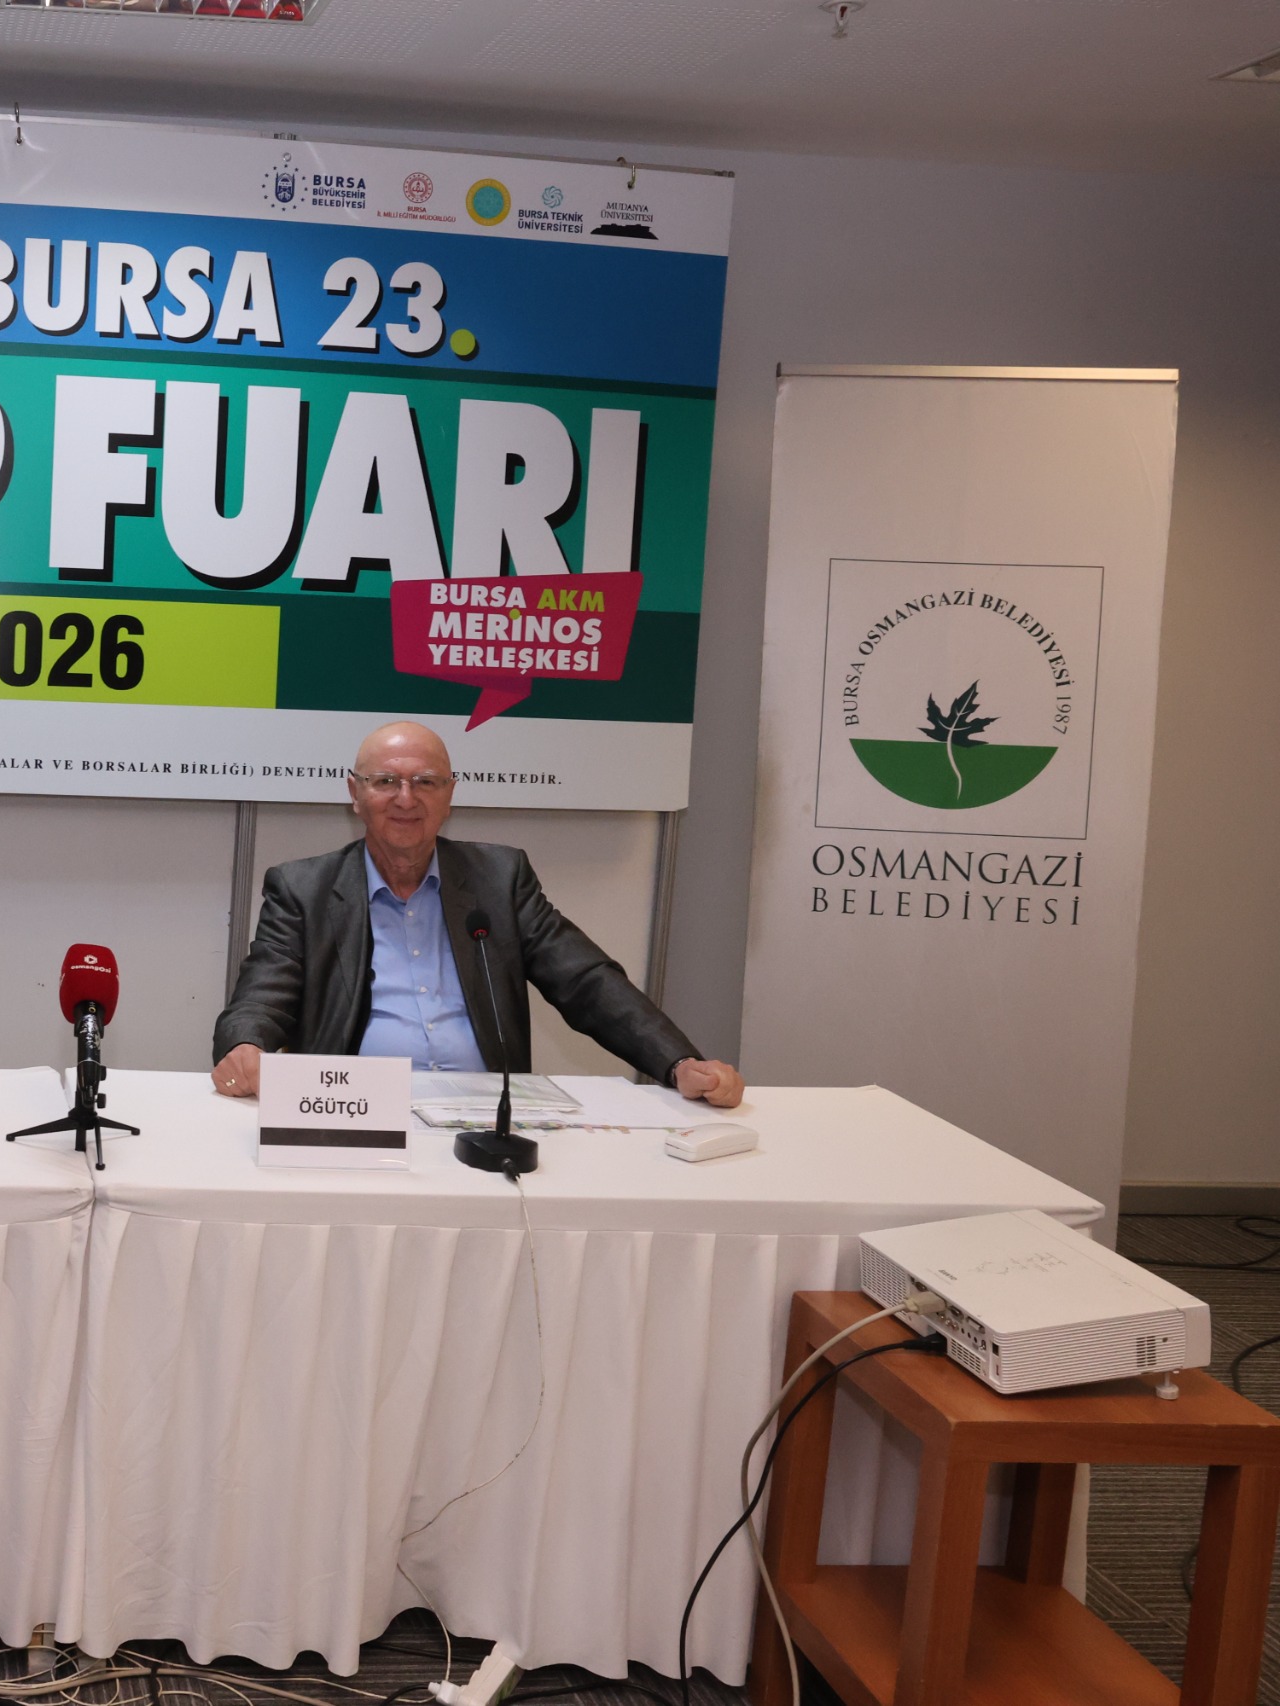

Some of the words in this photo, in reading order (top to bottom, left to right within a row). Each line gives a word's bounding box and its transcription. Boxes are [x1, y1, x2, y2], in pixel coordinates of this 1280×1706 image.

[313, 174, 366, 189] BURSA
[312, 187, 366, 199] BÜYÜKŞEHİR
[312, 197, 365, 209] BELEDİYESİ
[518, 209, 548, 219] BURSA
[551, 211, 583, 222] TEKNİK
[518, 219, 583, 233] ÜNİVERSİTESİ
[317, 256, 477, 358] 23.
[48, 374, 644, 583] FUARI
[430, 584, 526, 609] BURSA
[536, 587, 605, 612] AKM
[428, 608, 603, 645] MERİNOS
[428, 643, 598, 676] YERLEŞKESİ
[843, 660, 865, 727] BURSA
[858, 588, 975, 656] OSMANGAZİ
[979, 593, 1075, 687] BELEDİYESİ
[1052, 695, 1072, 735] 1987
[52, 759, 74, 770] VE
[81, 760, 172, 774] BORSALAR
[180, 761, 255, 777] BİRLİĞİ)
[262, 764, 356, 778] DENETİMİN
[452, 771, 562, 784] ENMEKTEDİR.
[812, 843, 1084, 888] OSMANGAZİ
[812, 886, 1080, 926] BELEDİYESİ
[320, 1070, 350, 1088] IŞIK
[298, 1096, 369, 1118] ÖĞÜTÇÜ
